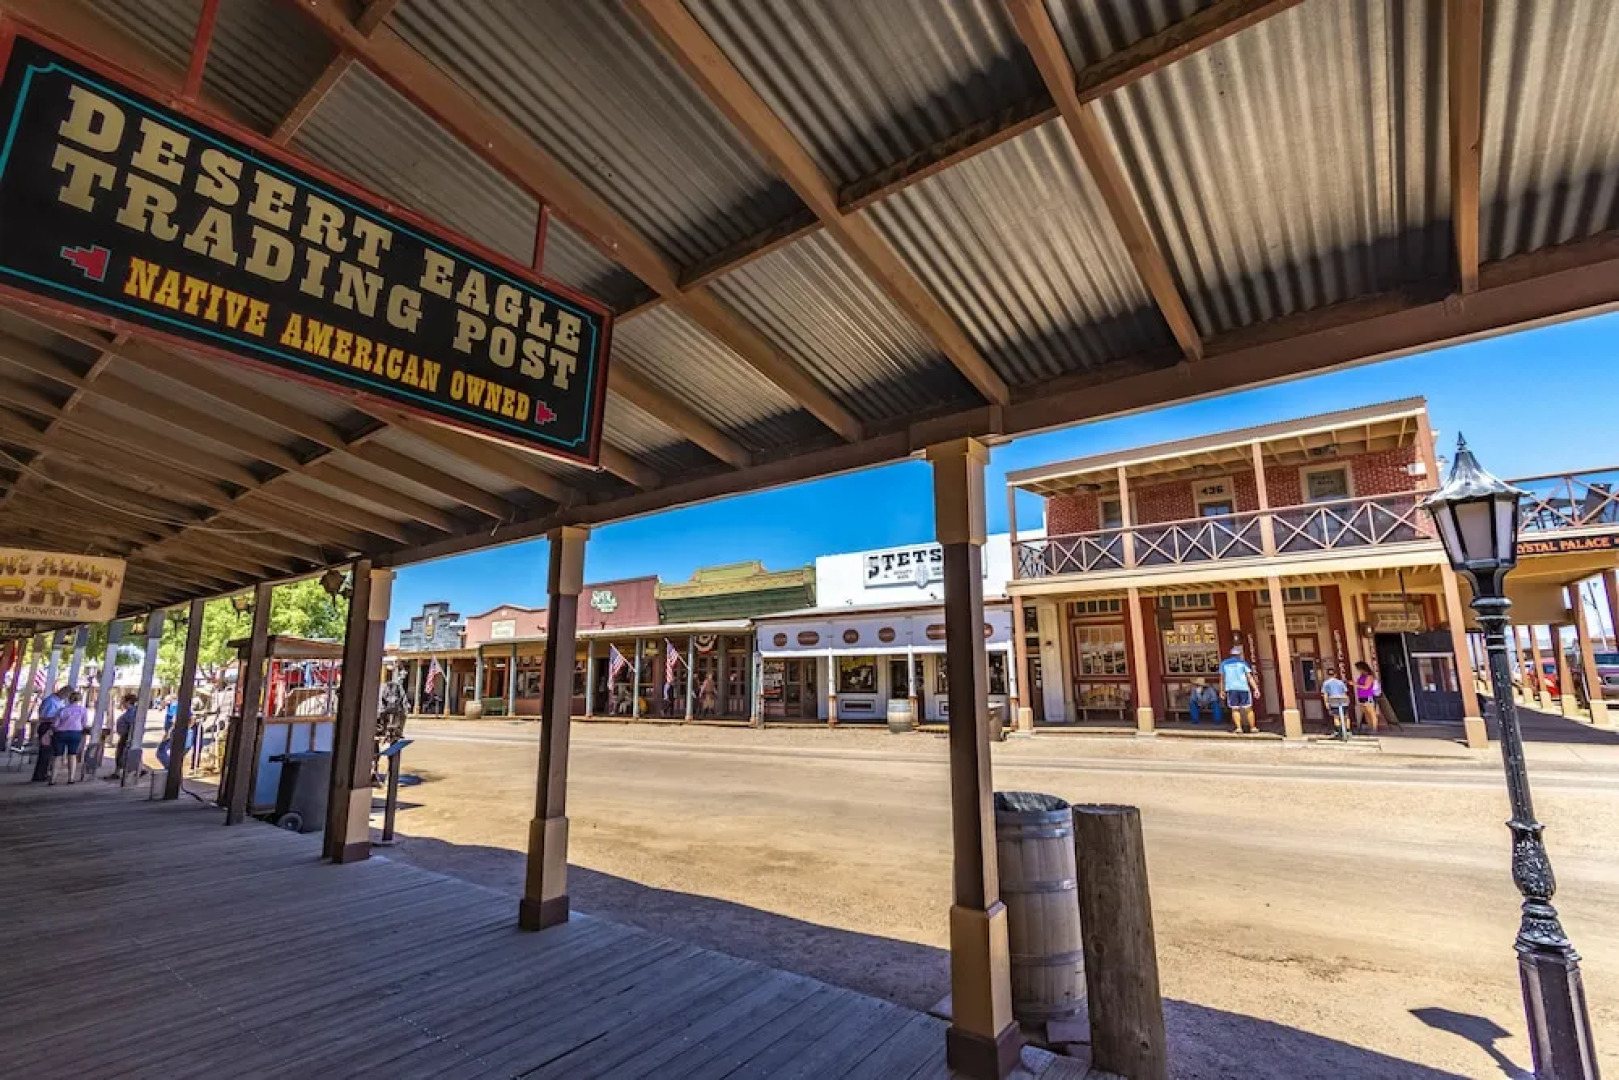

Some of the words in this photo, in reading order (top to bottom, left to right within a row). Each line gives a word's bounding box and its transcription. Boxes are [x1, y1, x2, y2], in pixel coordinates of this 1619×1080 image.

[52, 143, 424, 334] TRADING
[453, 309, 577, 390] POST
[58, 84, 393, 269] DESERT
[420, 247, 583, 354] EAGLE
[123, 256, 270, 338] NATIVE
[280, 312, 442, 393] AMERICAN
[450, 369, 531, 422] OWNED
[14, 605, 79, 618] SANDWICHES
[1561, 536, 1613, 551] PALACE
